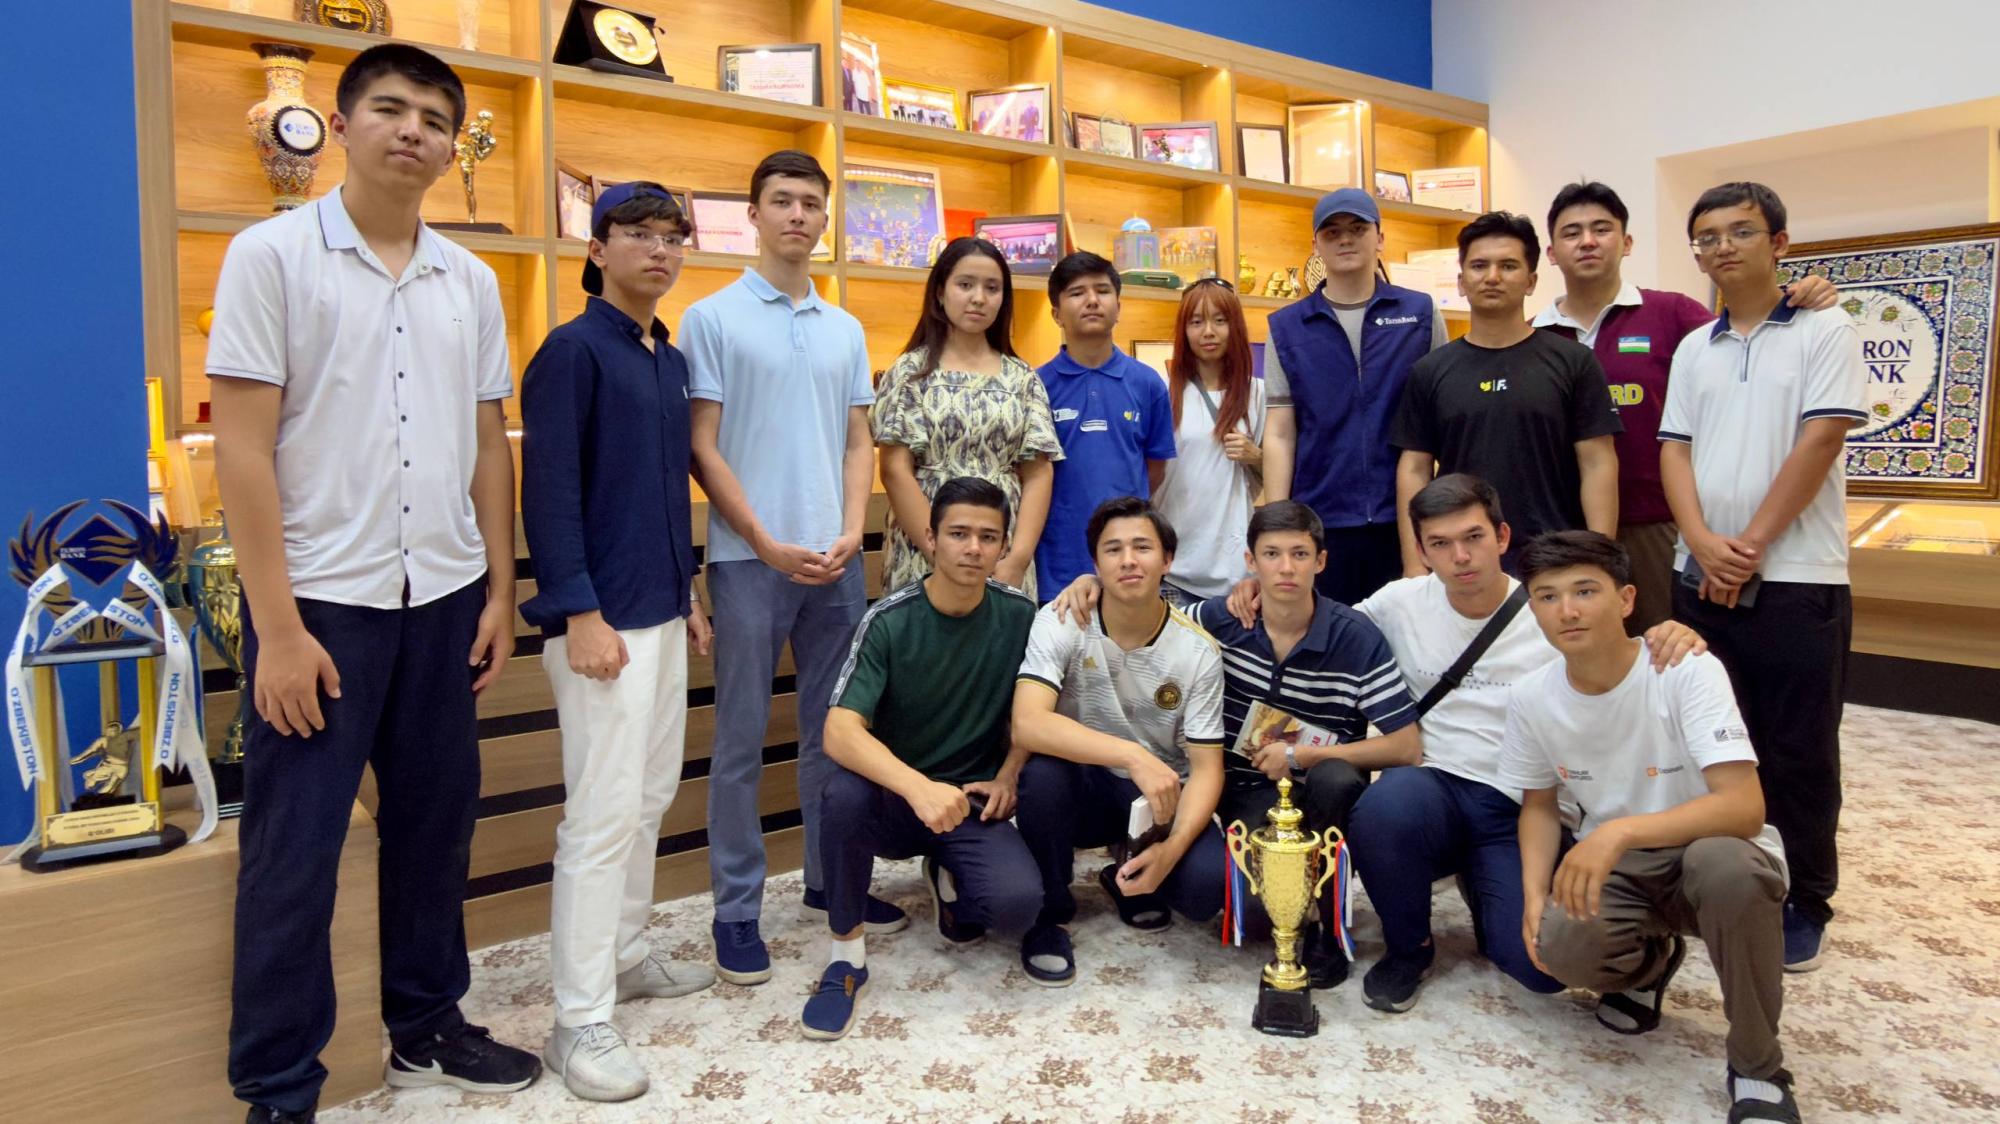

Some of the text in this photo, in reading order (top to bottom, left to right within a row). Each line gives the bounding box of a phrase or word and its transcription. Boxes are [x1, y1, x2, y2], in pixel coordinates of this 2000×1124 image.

[1863, 339, 1914, 359] RON
[1867, 364, 1908, 384] NK
[1607, 383, 1644, 406] RD
[107, 604, 146, 628] STON
[160, 673, 181, 759] O'ZBEKISTON
[11, 687, 39, 775] O'ZBEKISTON
